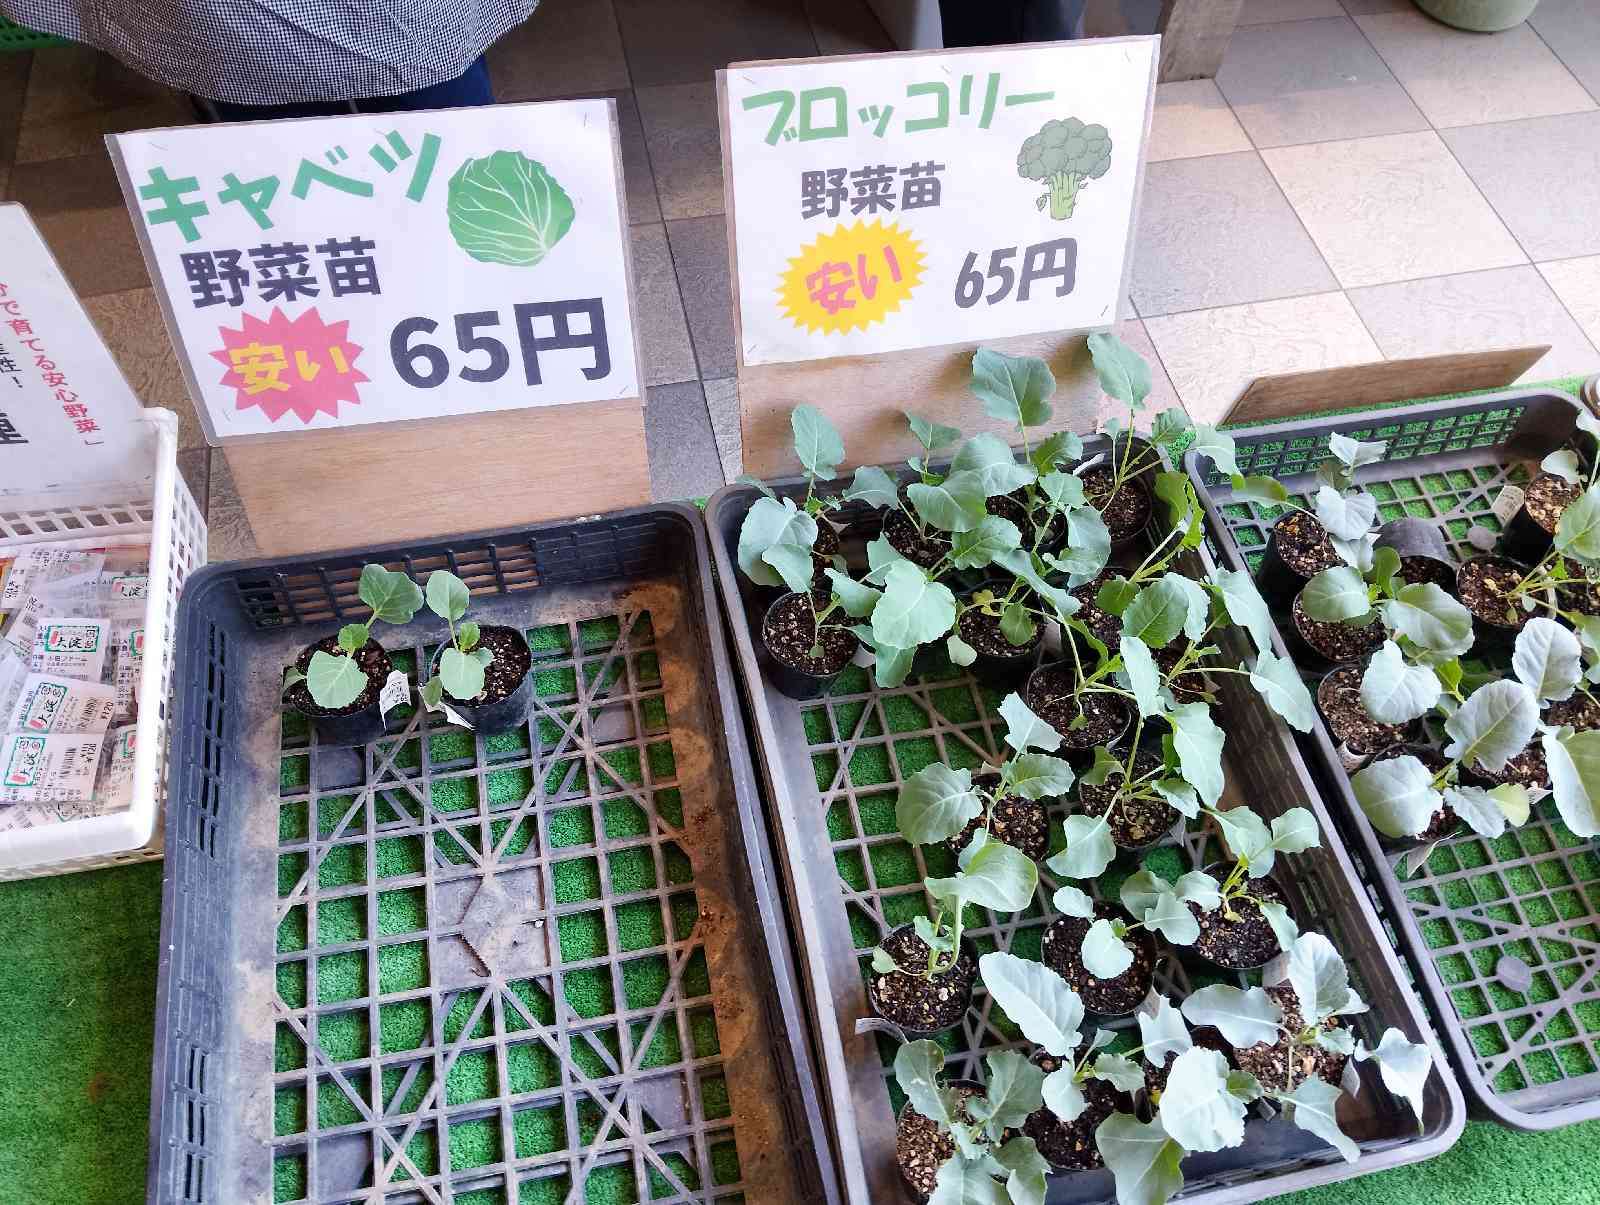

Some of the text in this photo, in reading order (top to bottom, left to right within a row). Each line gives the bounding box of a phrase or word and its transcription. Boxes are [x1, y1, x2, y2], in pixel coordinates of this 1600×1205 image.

[742, 72, 1055, 146] ブロッコリー
[139, 129, 442, 244] キャベツ
[801, 160, 946, 219] 野菜苗
[180, 236, 382, 308] 野菜苗
[806, 245, 903, 315] 安い
[954, 237, 1077, 308] 65円
[229, 343, 349, 396] 安い
[390, 297, 611, 389] 65円
